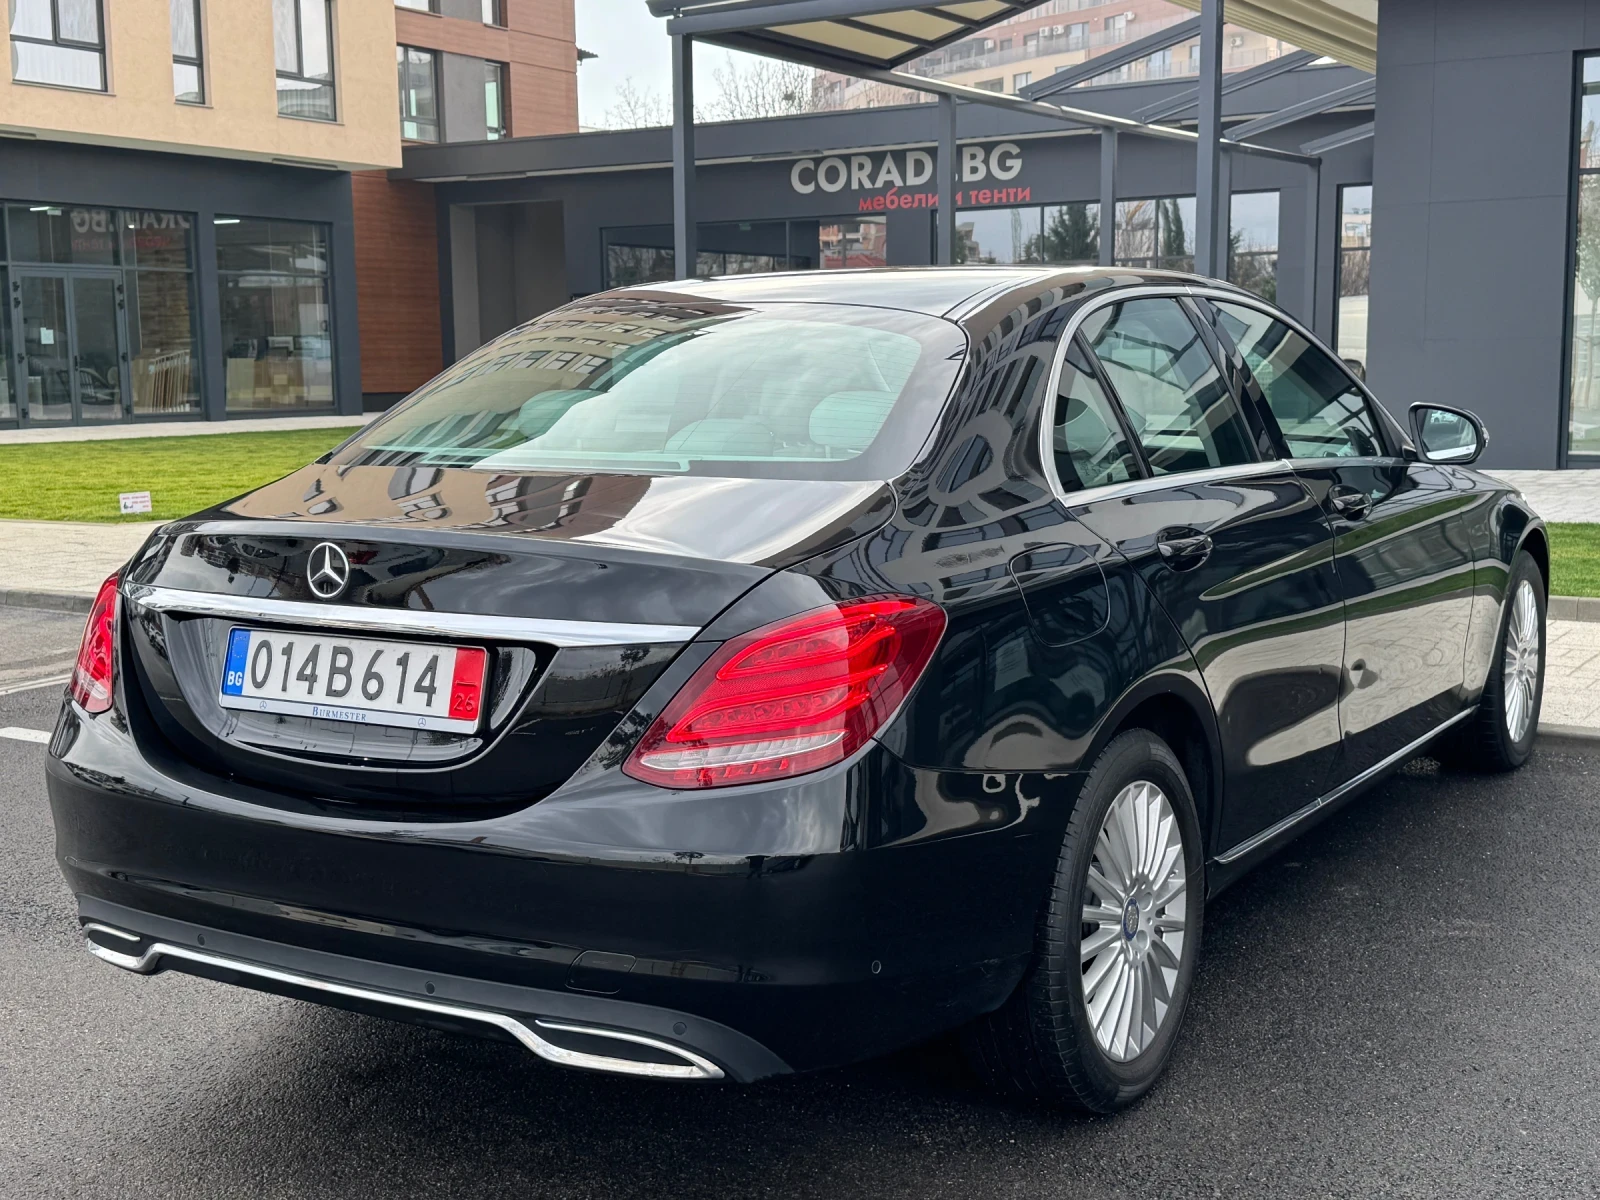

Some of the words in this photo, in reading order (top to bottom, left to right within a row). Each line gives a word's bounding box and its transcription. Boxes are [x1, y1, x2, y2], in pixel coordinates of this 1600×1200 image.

[790, 143, 1023, 194] CORADBG
[858, 186, 939, 211] мебели
[969, 186, 1031, 205] тенти
[227, 670, 243, 686] BG
[250, 639, 439, 708] 014B614
[312, 706, 367, 722] BURMESTER
[453, 692, 476, 713] 26
